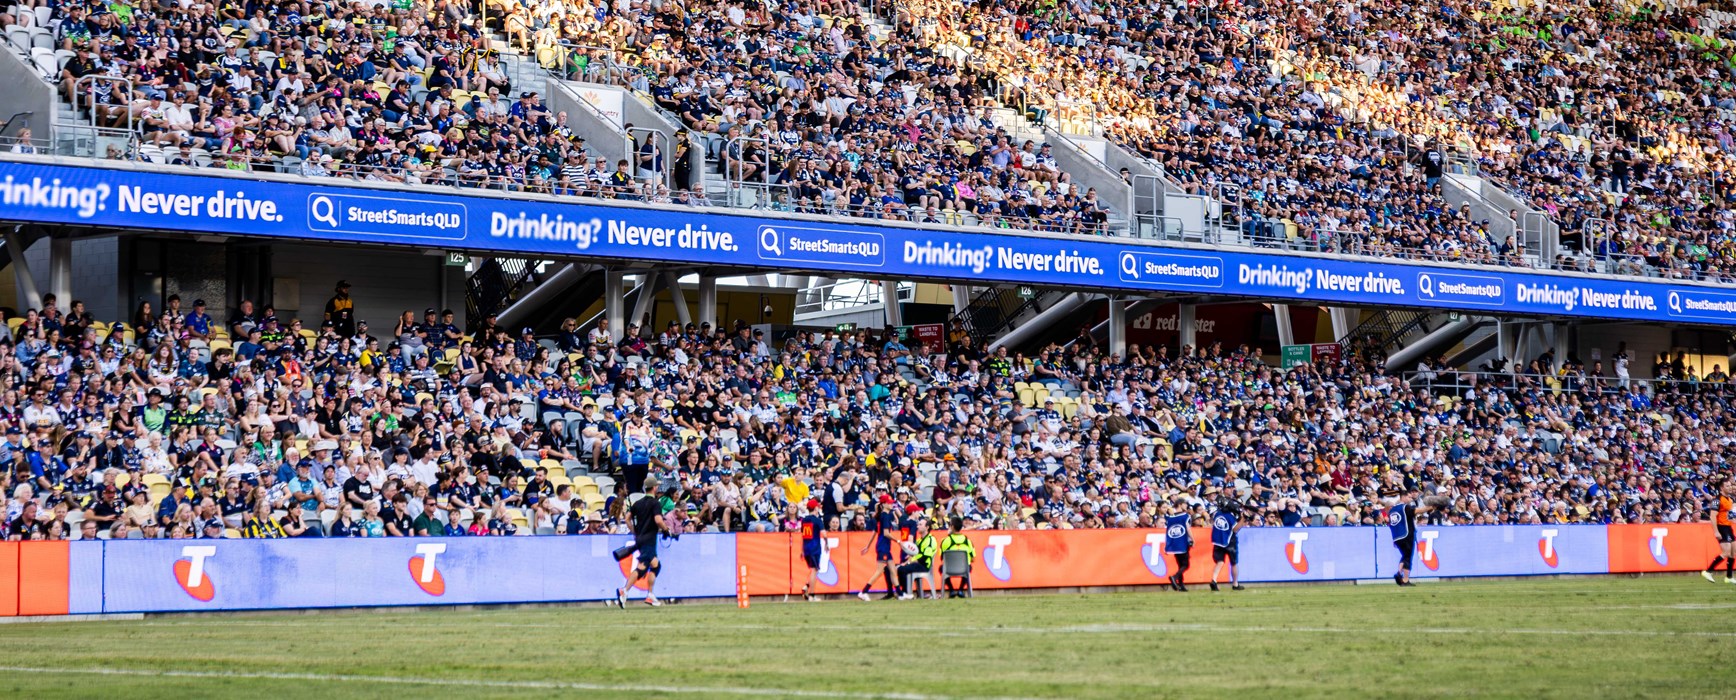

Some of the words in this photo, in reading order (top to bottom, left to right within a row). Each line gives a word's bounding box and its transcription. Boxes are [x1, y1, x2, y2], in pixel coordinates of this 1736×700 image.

[118, 185, 203, 217] Never
[206, 190, 283, 223] drive.
[347, 206, 460, 230] StreetSmartsQLD
[490, 211, 601, 249] Drinking?
[607, 219, 675, 248] Never
[677, 223, 739, 252] drive.
[789, 236, 880, 258] StreetSmartsQLD
[450, 252, 464, 263] 125
[903, 240, 993, 274] Drinking?
[997, 246, 1053, 272] Never
[1054, 249, 1104, 275] drive.
[1145, 261, 1219, 280] StreetSmartsQLD
[1238, 263, 1312, 294] Drinking?
[1316, 269, 1363, 292] Never
[1363, 271, 1405, 295] drive.
[1438, 280, 1501, 298] StreetSmartsQLD
[1516, 282, 1579, 311] Drinking?
[1581, 287, 1622, 309] Never
[1622, 289, 1658, 311] drive.
[1156, 314, 1176, 331] red
[1176, 318, 1215, 333] rster
[987, 535, 1012, 570] T
[1144, 533, 1167, 566] T
[1288, 532, 1309, 564] T
[1421, 530, 1440, 561] T
[1541, 529, 1559, 558] T
[1651, 528, 1669, 556] T
[181, 545, 217, 588] T
[414, 543, 447, 583] T
